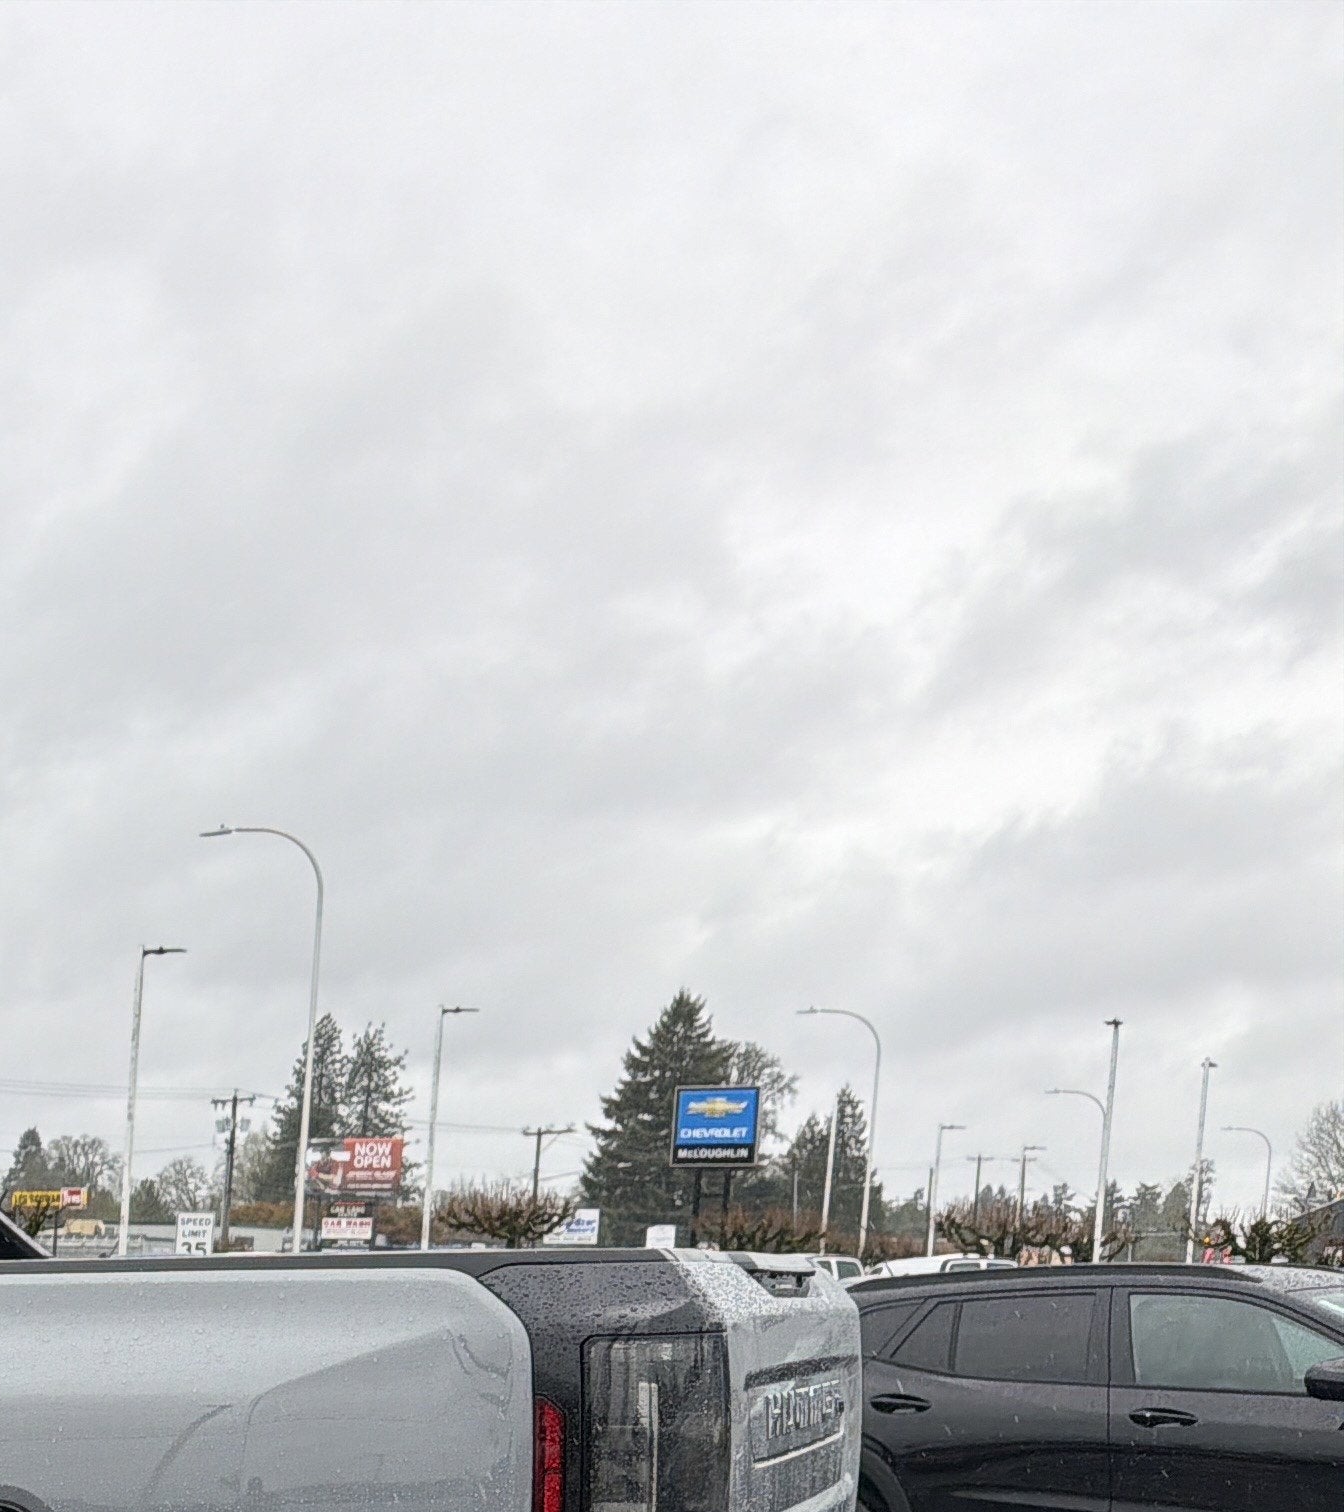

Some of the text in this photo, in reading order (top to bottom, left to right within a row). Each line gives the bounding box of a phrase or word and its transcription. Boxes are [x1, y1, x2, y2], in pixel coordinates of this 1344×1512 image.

[679, 1127, 748, 1139] CHEVROLET
[354, 1142, 393, 1157] NOW
[353, 1155, 392, 1169] OPEN
[180, 1217, 212, 1226] SPEED
[323, 1220, 371, 1228] CAR WASH
[182, 1230, 207, 1238] LIMIT
[181, 1241, 207, 1256] 35
